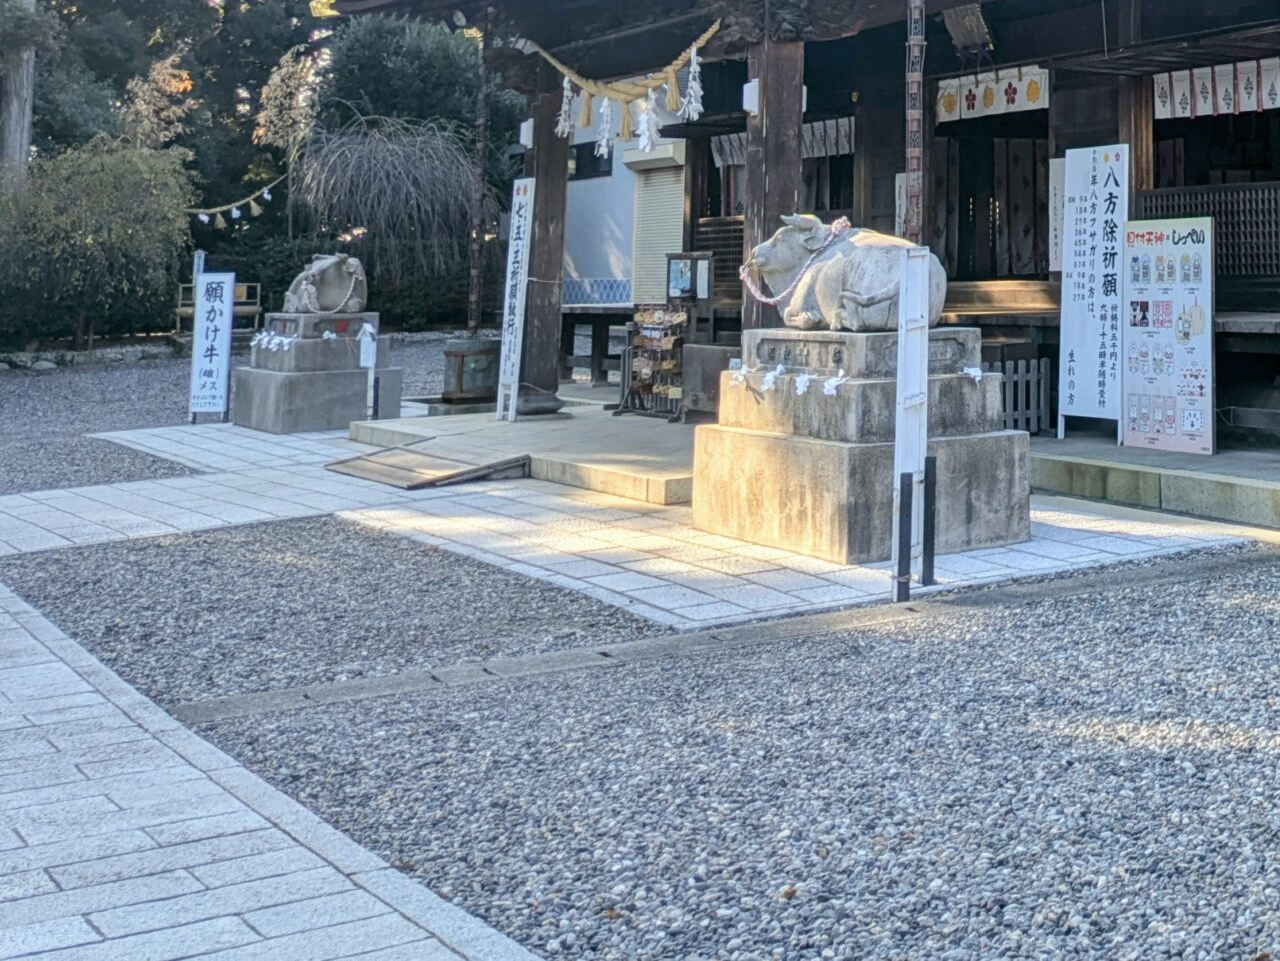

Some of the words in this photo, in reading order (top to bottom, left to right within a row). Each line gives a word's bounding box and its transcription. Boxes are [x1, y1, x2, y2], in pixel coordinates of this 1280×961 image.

[1102, 166, 1120, 297] 八方除祈願
[203, 281, 225, 364] 願かけ牛
[200, 381, 218, 391] メス
[1067, 349, 1075, 406] 生れの方
